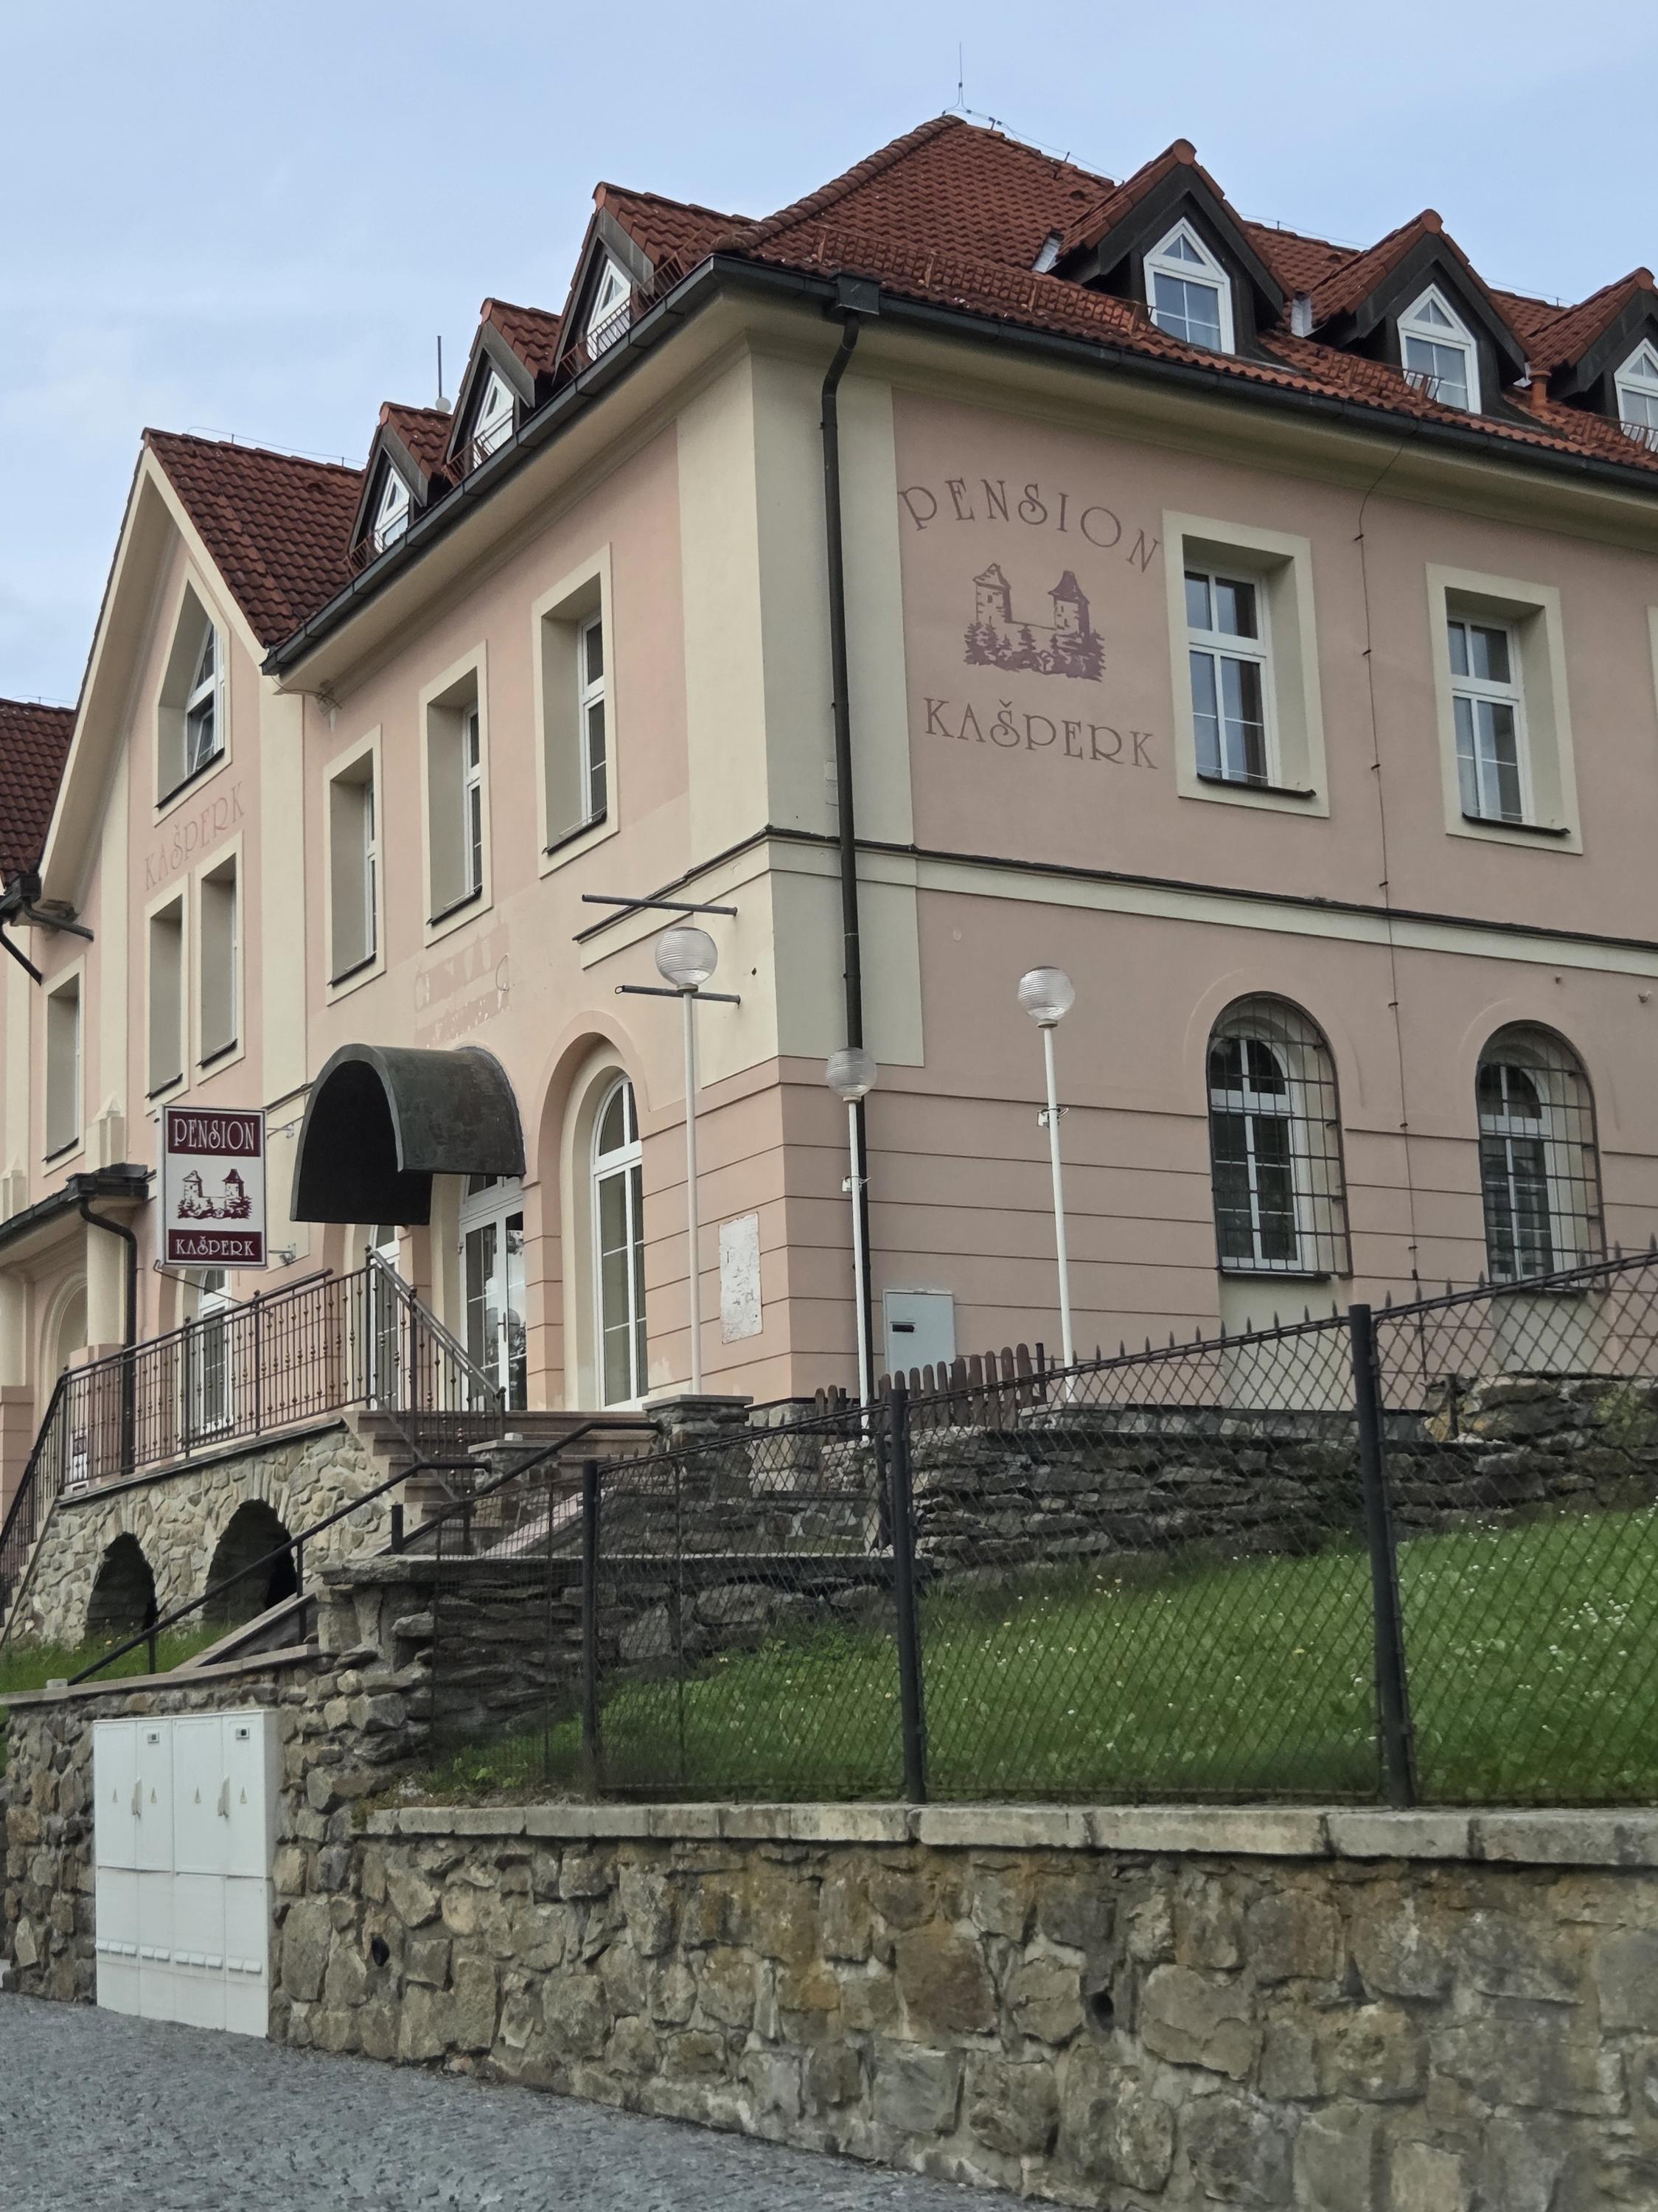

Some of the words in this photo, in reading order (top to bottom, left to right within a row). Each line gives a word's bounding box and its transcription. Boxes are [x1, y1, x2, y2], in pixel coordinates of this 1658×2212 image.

[898, 478, 1160, 573] PENSION
[923, 698, 1159, 770] KAŠPERK
[144, 781, 245, 891] KAŠPERK
[174, 1119, 254, 1150] PENSION
[176, 1236, 254, 1256] KAŠPERK
